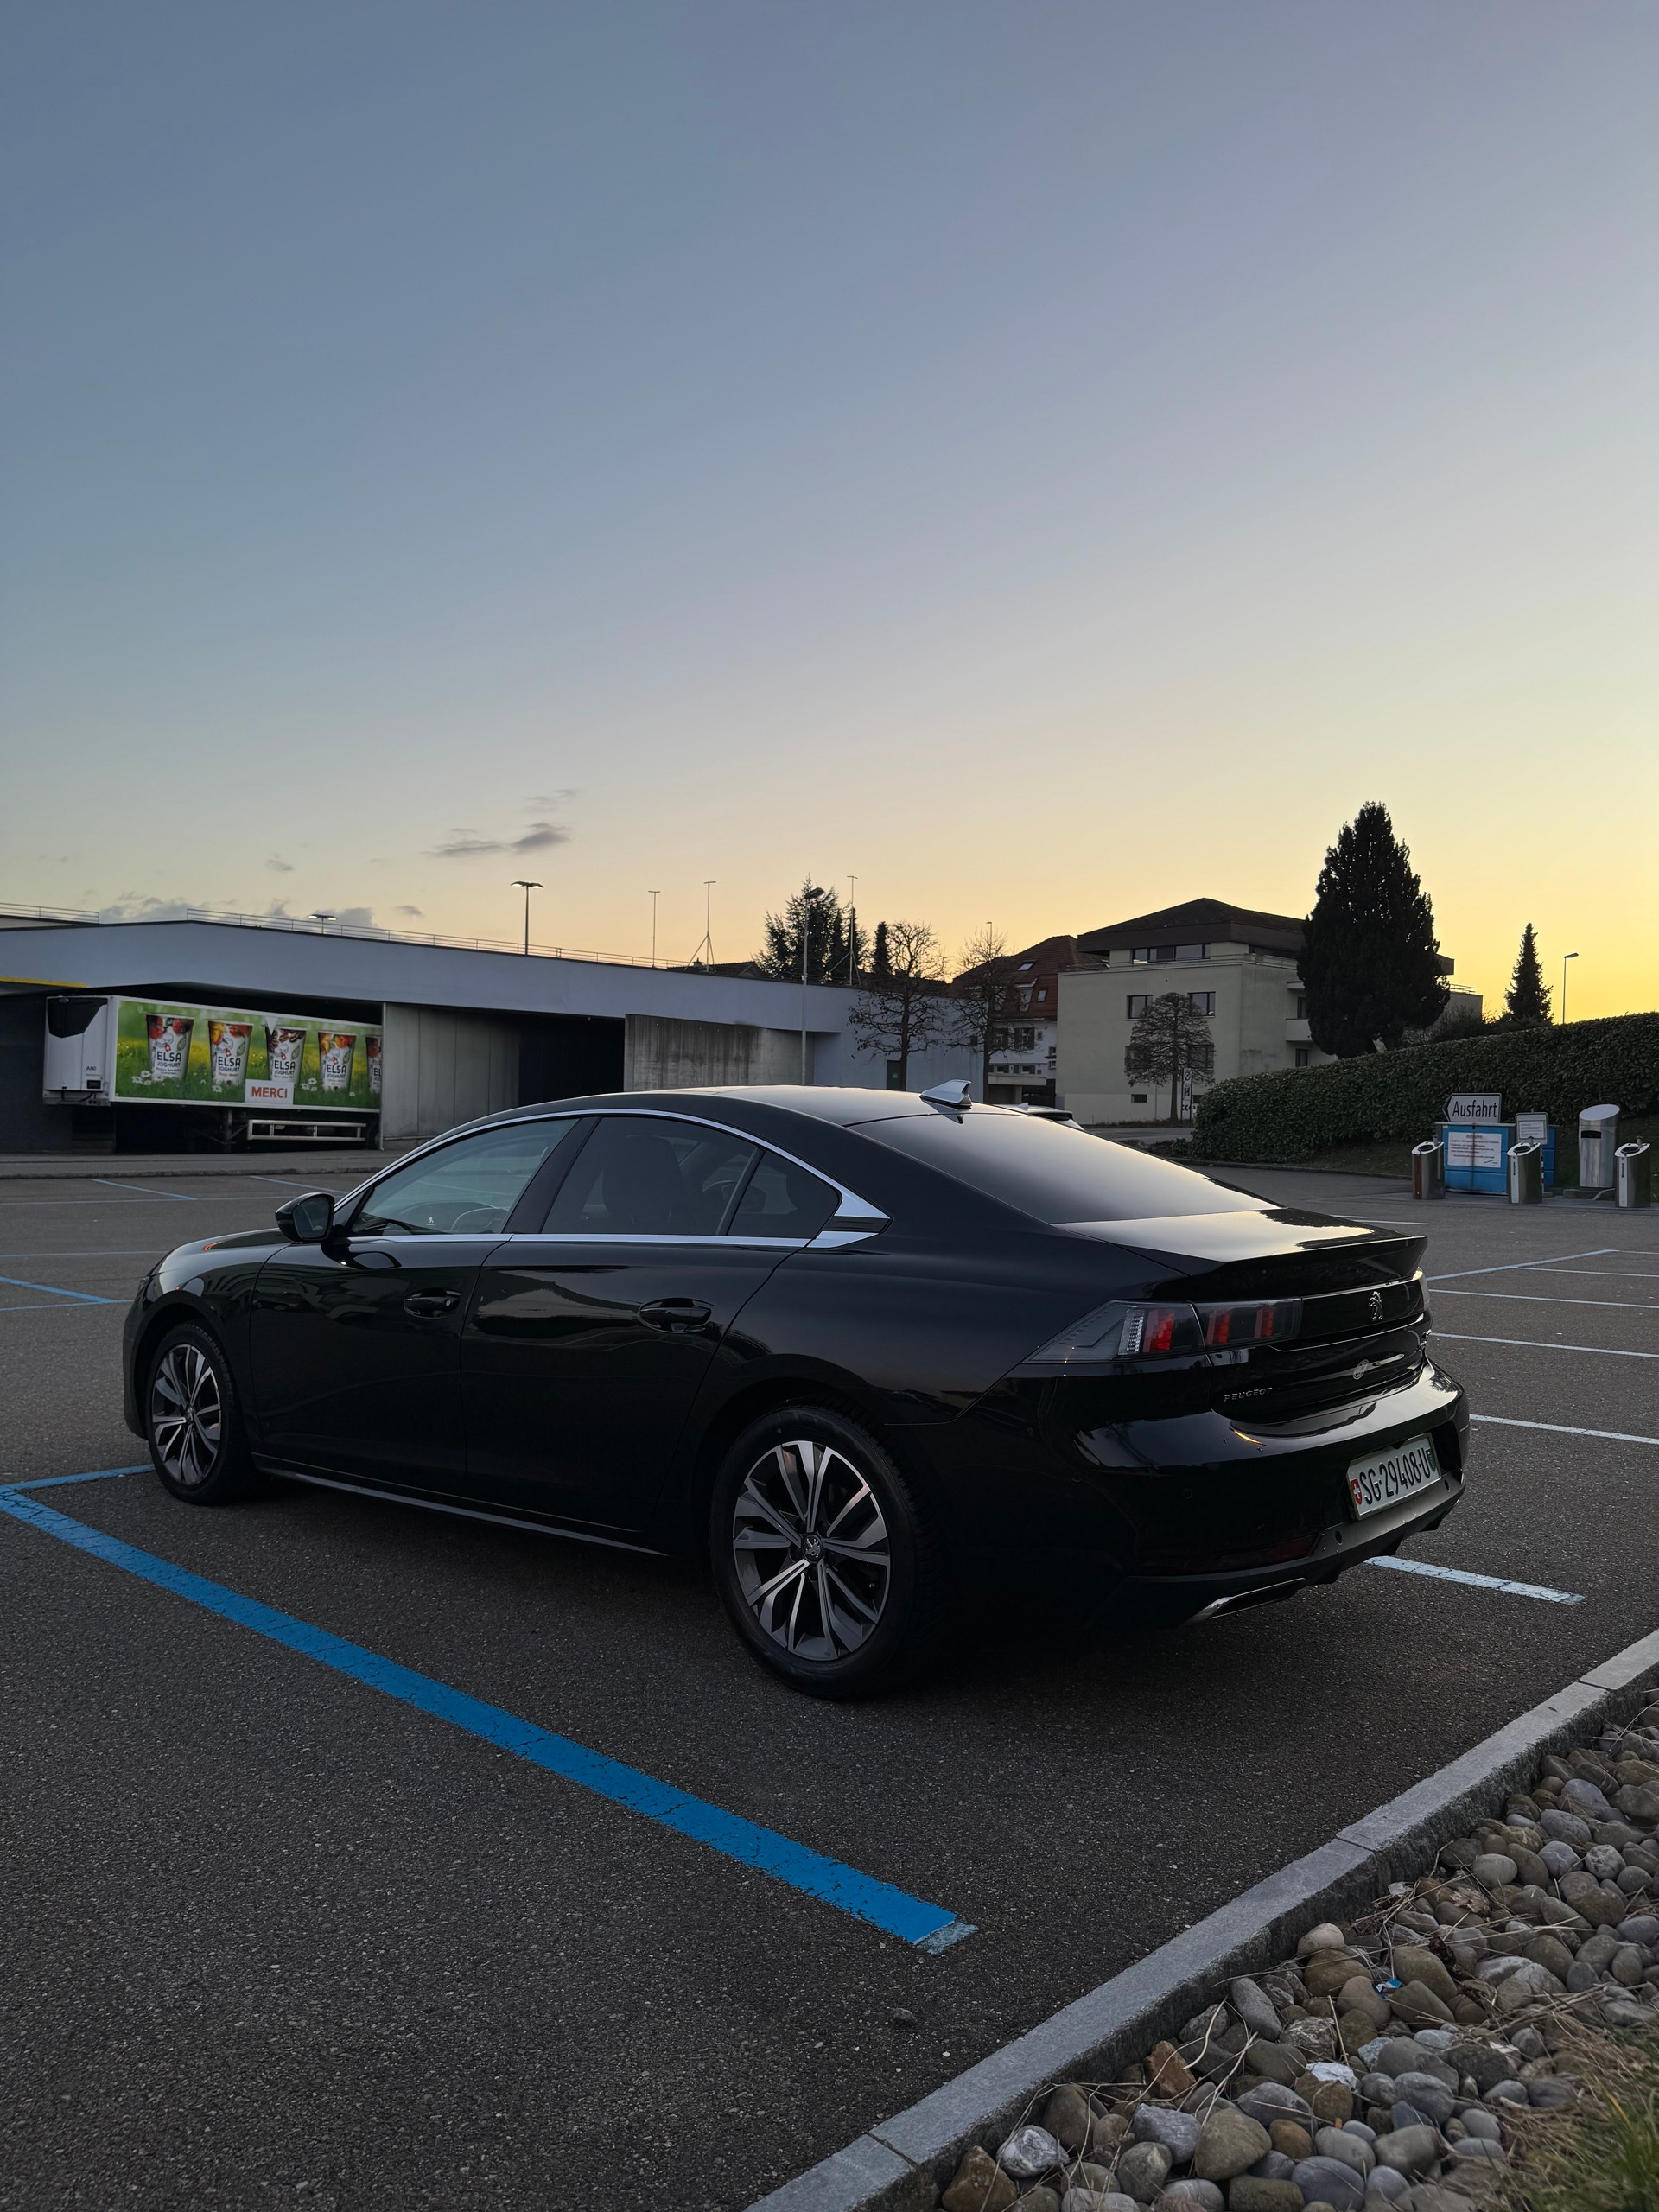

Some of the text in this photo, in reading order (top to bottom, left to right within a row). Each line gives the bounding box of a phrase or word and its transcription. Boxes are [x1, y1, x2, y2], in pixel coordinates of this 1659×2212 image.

[156, 1051, 181, 1062] ELSA
[218, 1056, 241, 1067] ELSA
[274, 1060, 296, 1071] ELSA
[327, 1064, 346, 1074] ELSA
[373, 1067, 382, 1077] EL
[251, 1086, 288, 1098] MERCI
[1452, 1099, 1497, 1118] Ausfahrt
[1224, 1387, 1273, 1402] PEUGEOT
